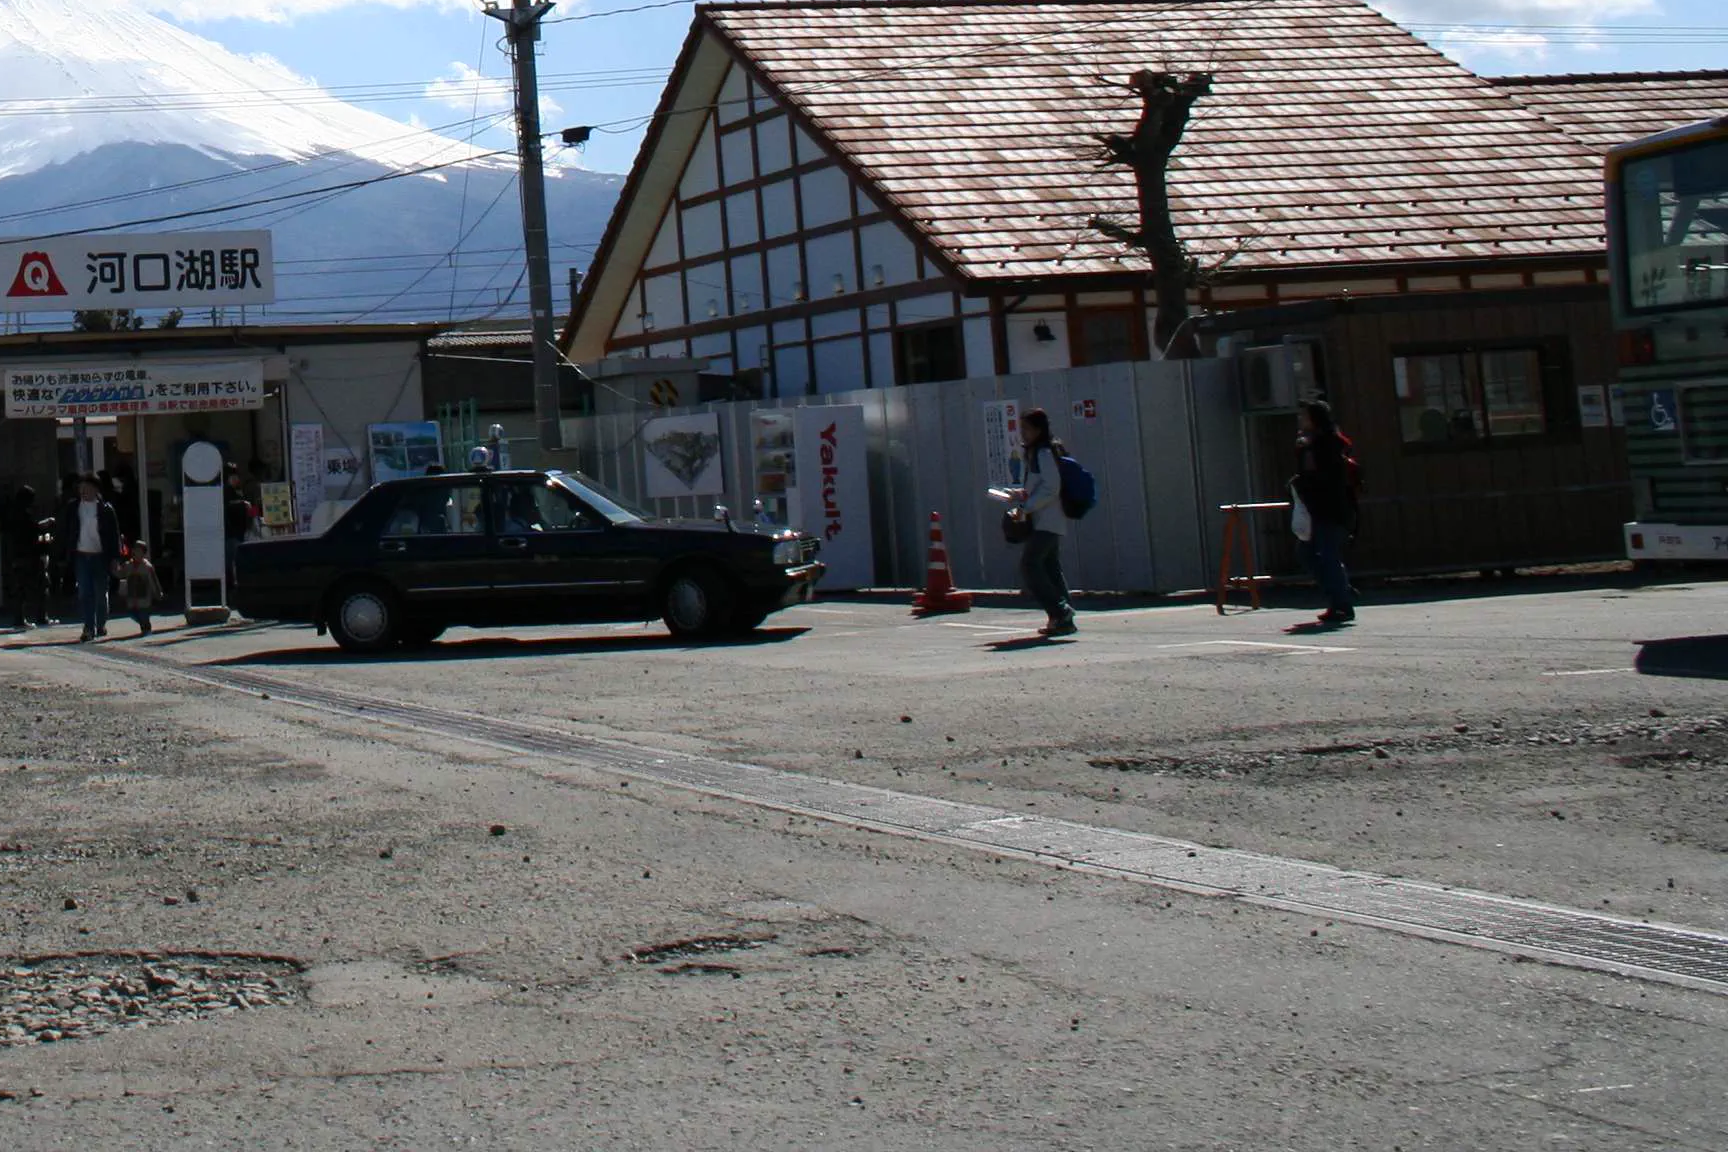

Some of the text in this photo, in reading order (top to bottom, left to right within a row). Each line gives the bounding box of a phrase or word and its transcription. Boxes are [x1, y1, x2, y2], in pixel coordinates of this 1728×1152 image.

[87, 248, 261, 293] 河口湖駅
[820, 421, 843, 540] Yakult
